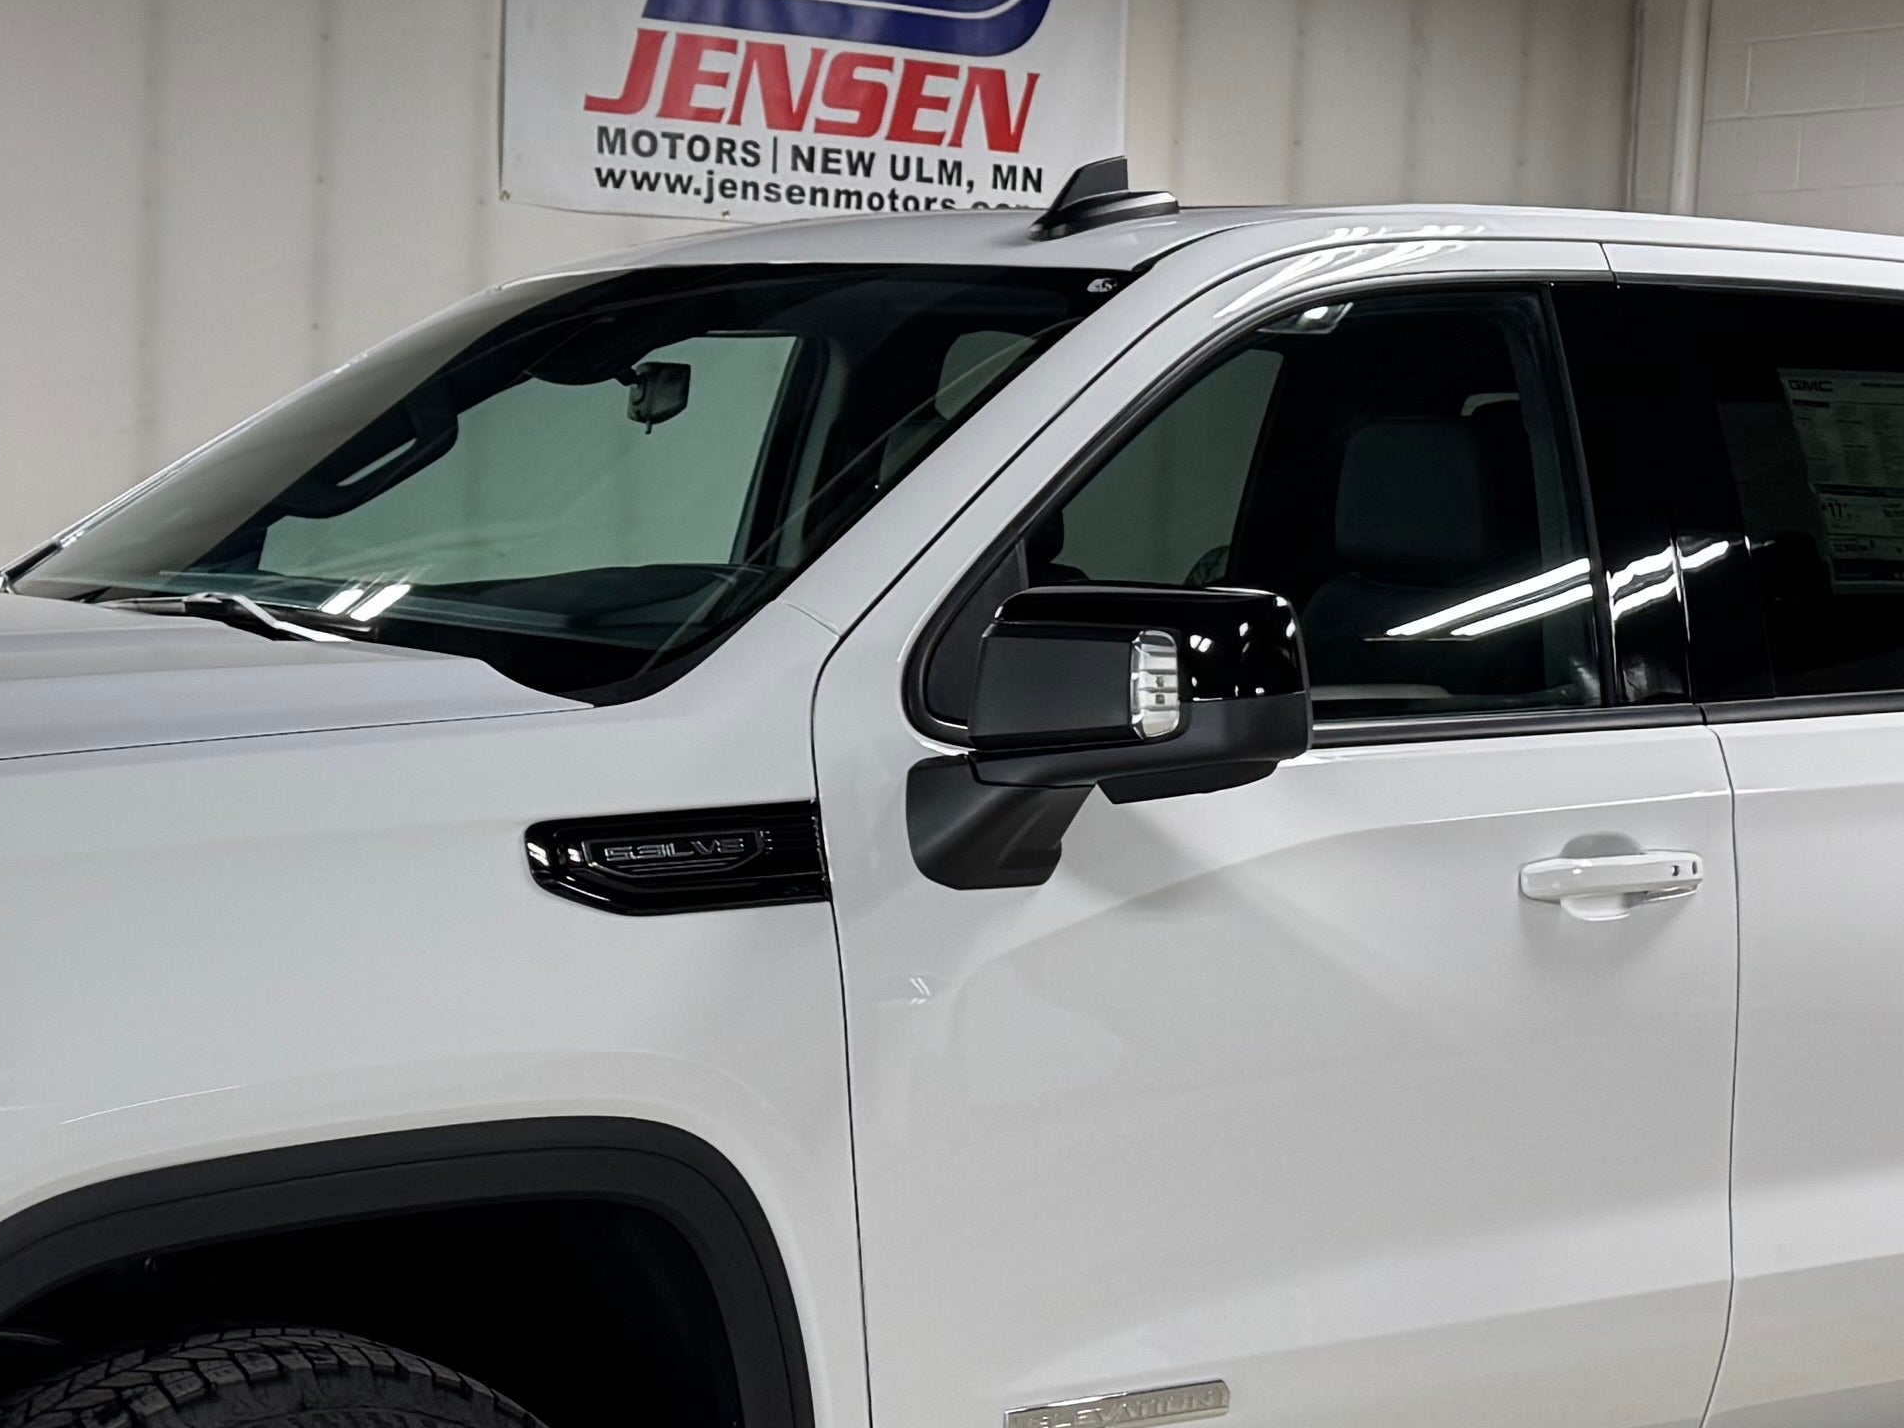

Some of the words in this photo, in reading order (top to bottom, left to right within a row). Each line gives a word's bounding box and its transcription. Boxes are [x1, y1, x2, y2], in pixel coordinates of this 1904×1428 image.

[583, 28, 1040, 153] JENSEN
[596, 125, 762, 168] MOTORS
[791, 143, 876, 178] NEW
[890, 154, 975, 194] ULM,
[991, 163, 1043, 194] MN
[595, 166, 1032, 213] www.jensenmotors
[1787, 379, 1835, 394] GMC
